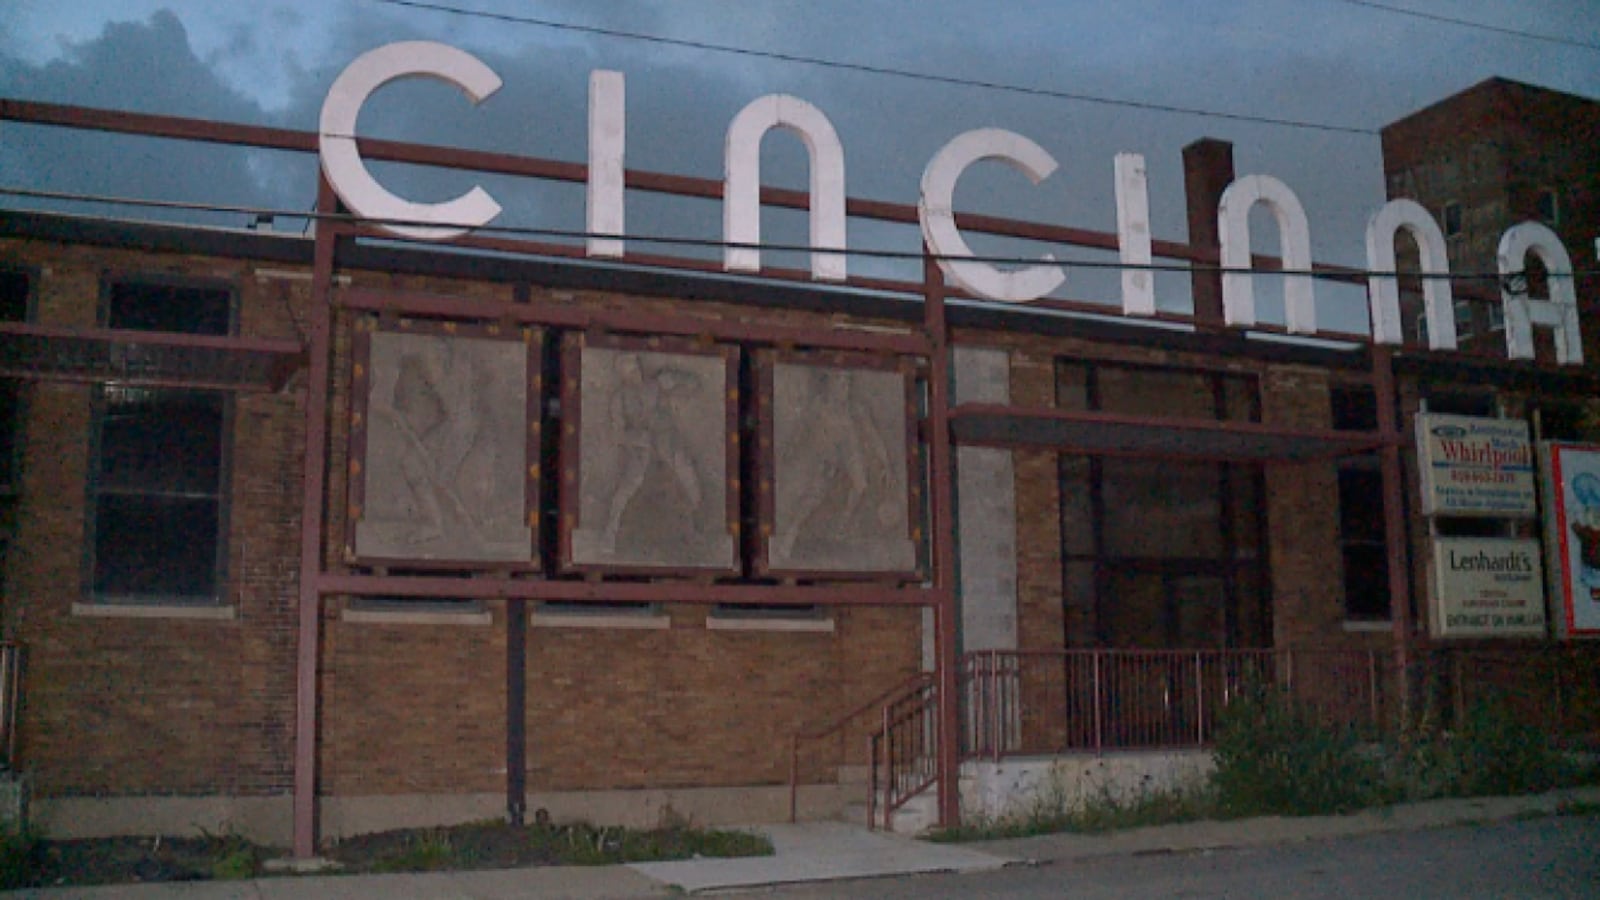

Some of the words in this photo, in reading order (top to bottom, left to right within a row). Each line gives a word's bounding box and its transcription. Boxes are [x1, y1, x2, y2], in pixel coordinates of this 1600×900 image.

[319, 40, 1600, 366] CINCINNA
[1441, 439, 1529, 469] Whirlpool
[1450, 549, 1532, 572] Lenhardt's
